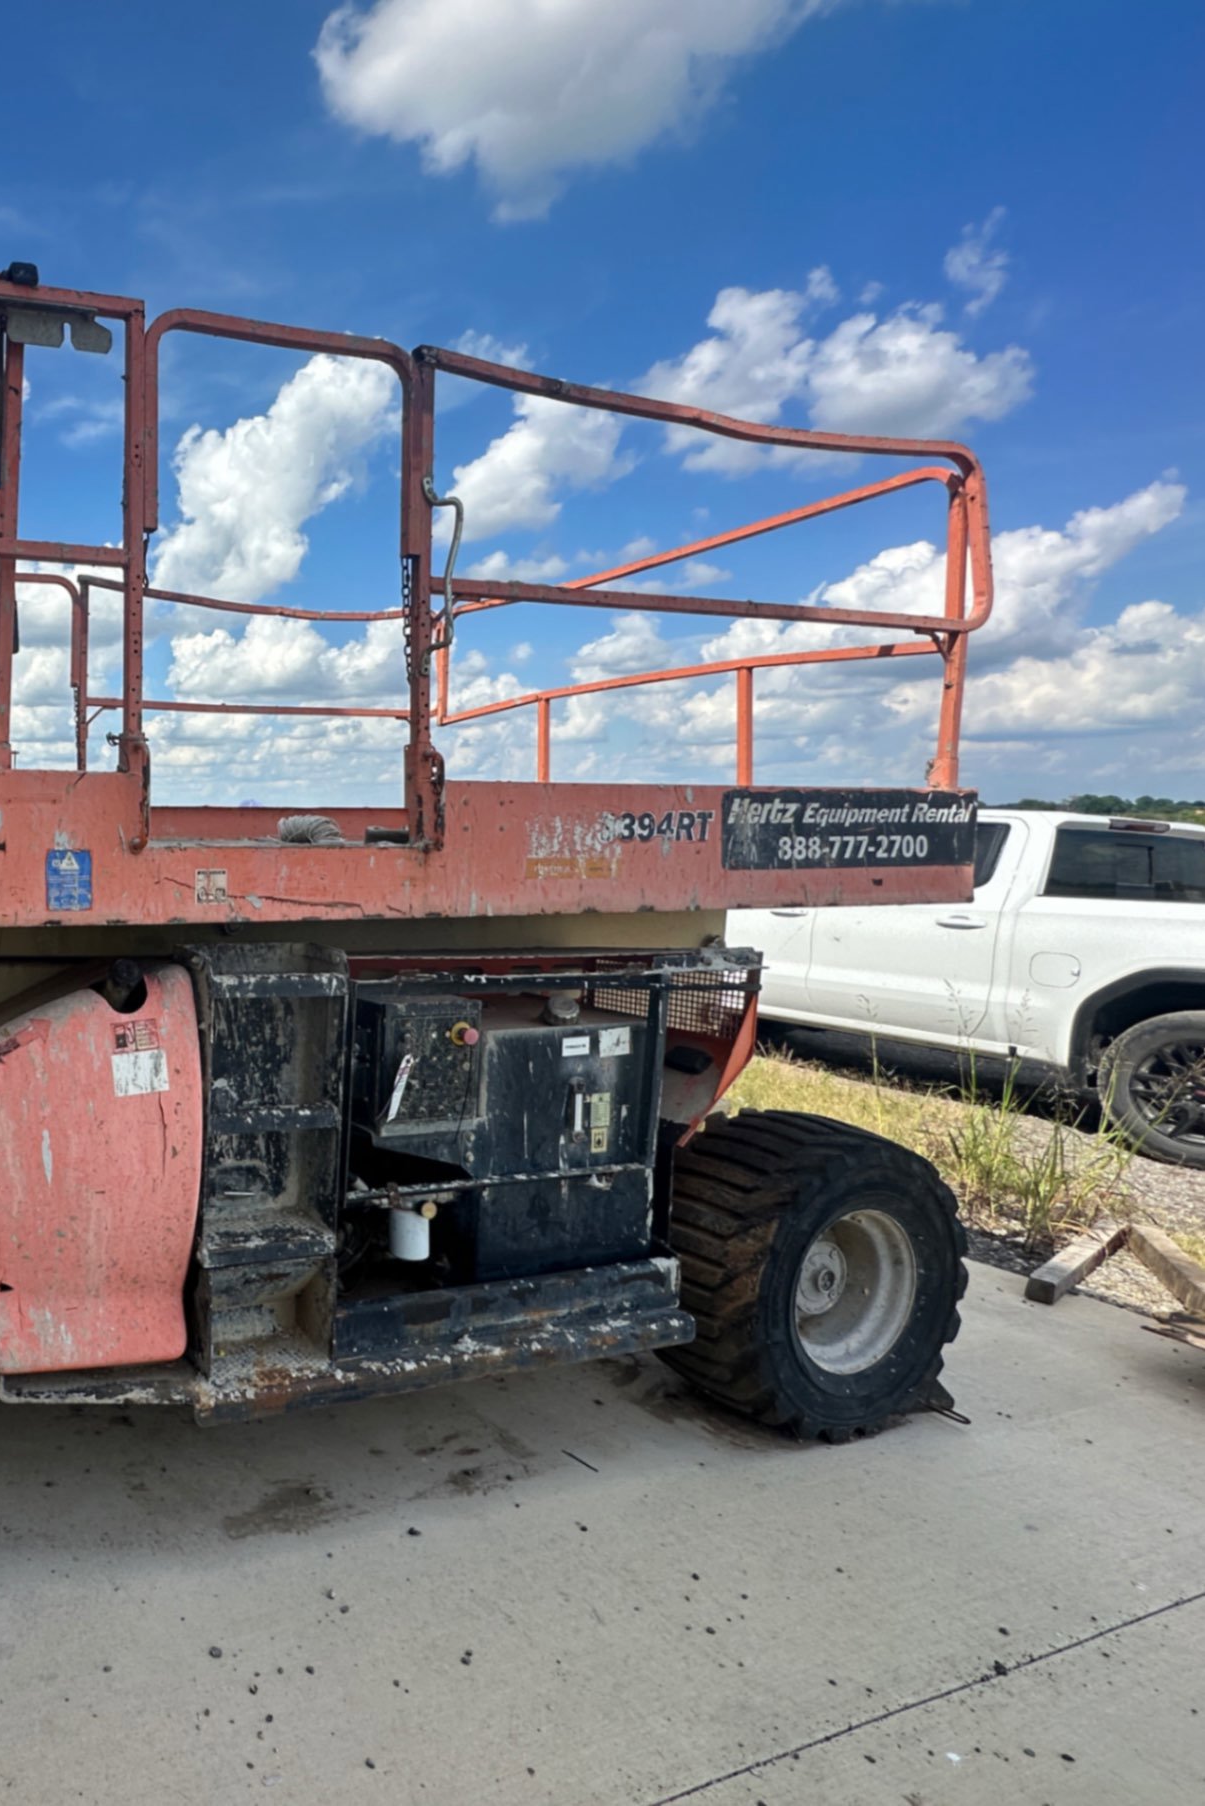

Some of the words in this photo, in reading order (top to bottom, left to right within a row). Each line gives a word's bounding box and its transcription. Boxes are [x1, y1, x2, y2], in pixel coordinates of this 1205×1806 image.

[727, 798, 800, 825] Hertz
[802, 802, 911, 827] Equipment
[911, 802, 974, 824] Rental
[777, 834, 929, 861] 888-777-2700
